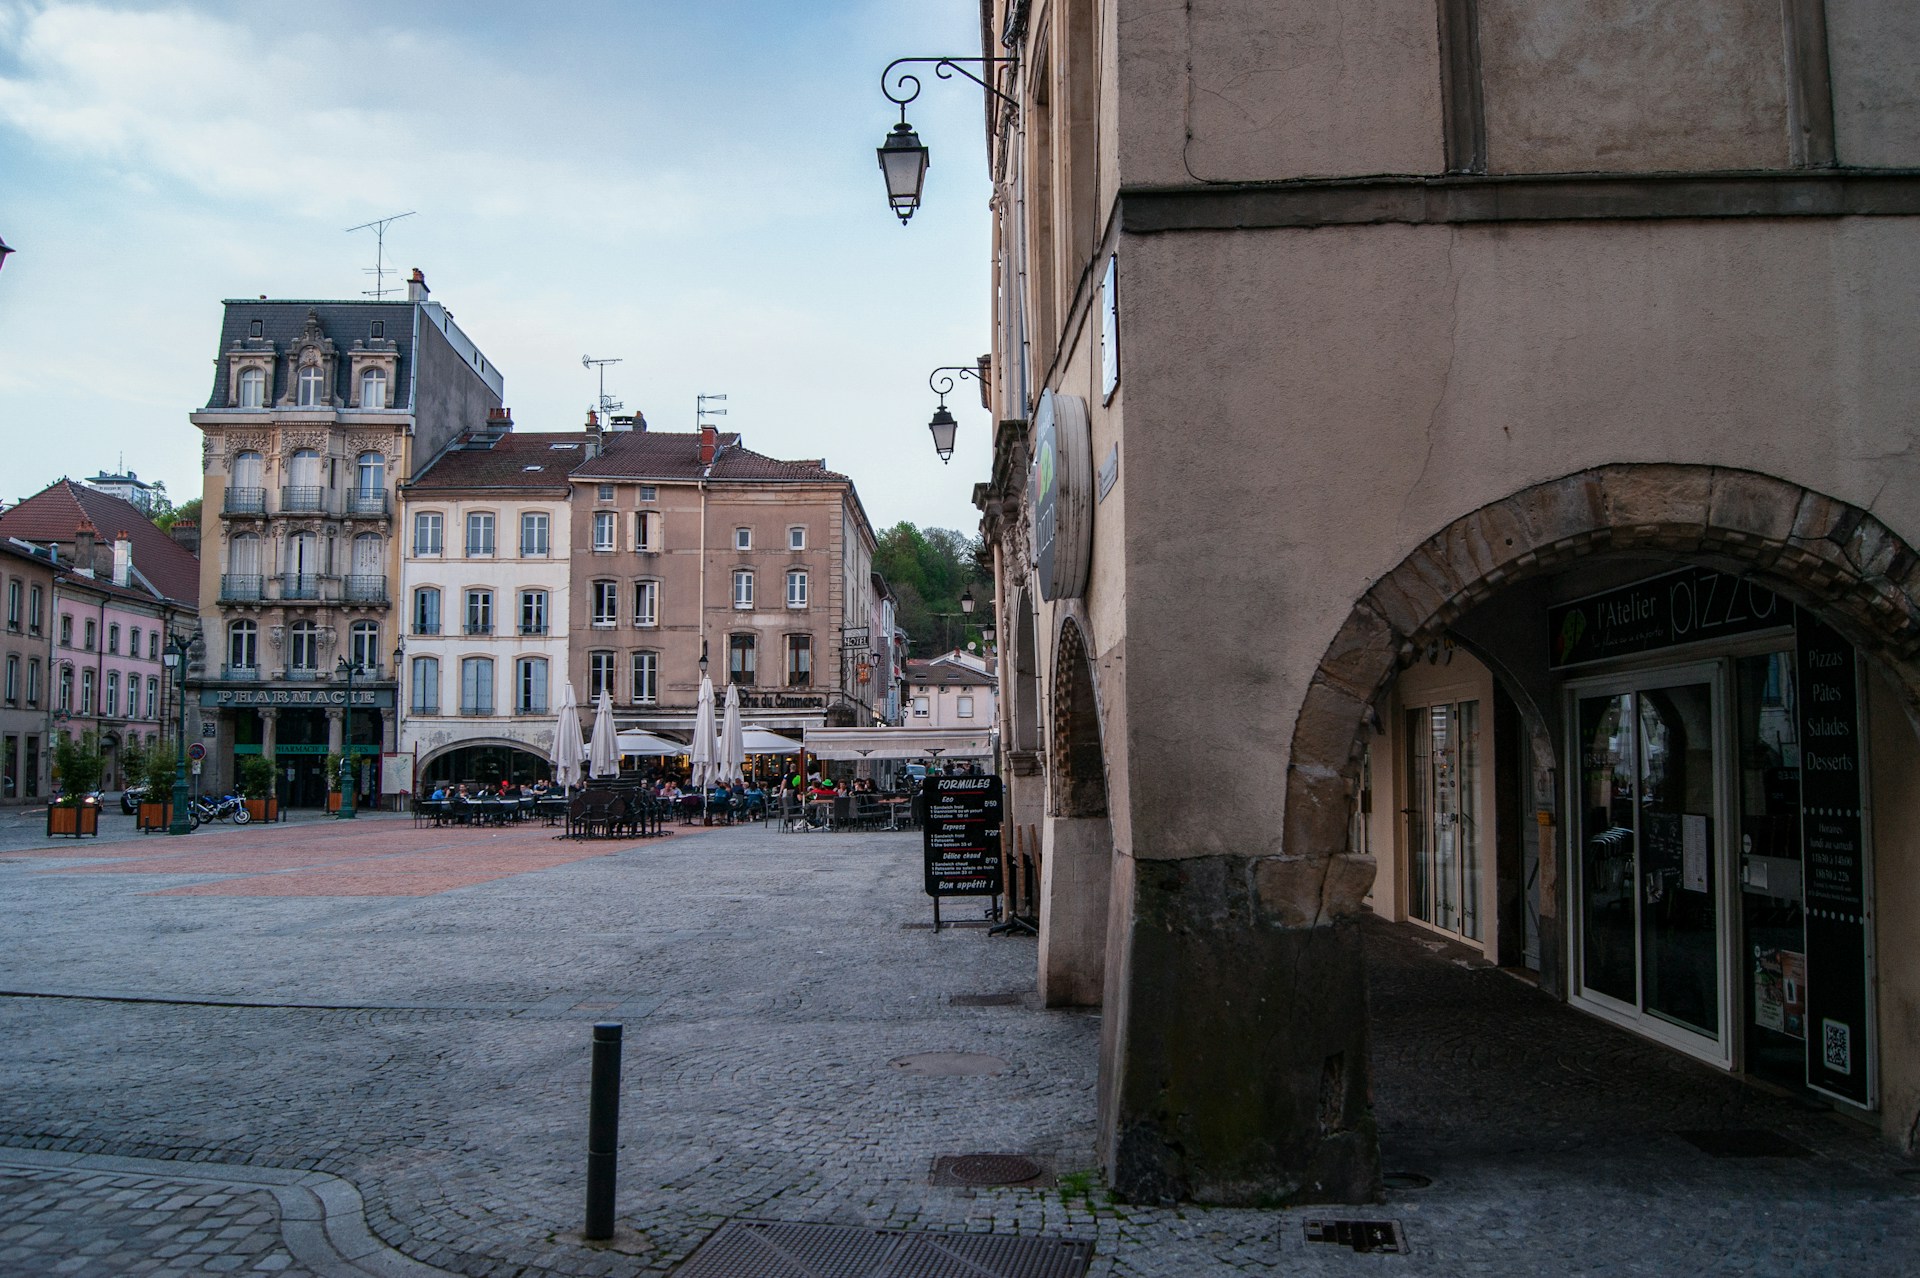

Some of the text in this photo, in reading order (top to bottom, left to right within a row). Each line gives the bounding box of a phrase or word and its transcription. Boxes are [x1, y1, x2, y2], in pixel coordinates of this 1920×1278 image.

[1597, 592, 1657, 630] l'Atelier
[1808, 649, 1842, 668] Pizzas
[216, 690, 375, 704] PHARMACIE
[761, 694, 772, 708] du
[775, 694, 822, 708] Commerce
[1812, 682, 1842, 702] Pâtes
[1808, 716, 1849, 737] Salades
[1807, 752, 1854, 771] Desserts
[938, 778, 991, 790] FORMULES
[938, 880, 954, 889] Bon
[957, 879, 987, 890] appétit
